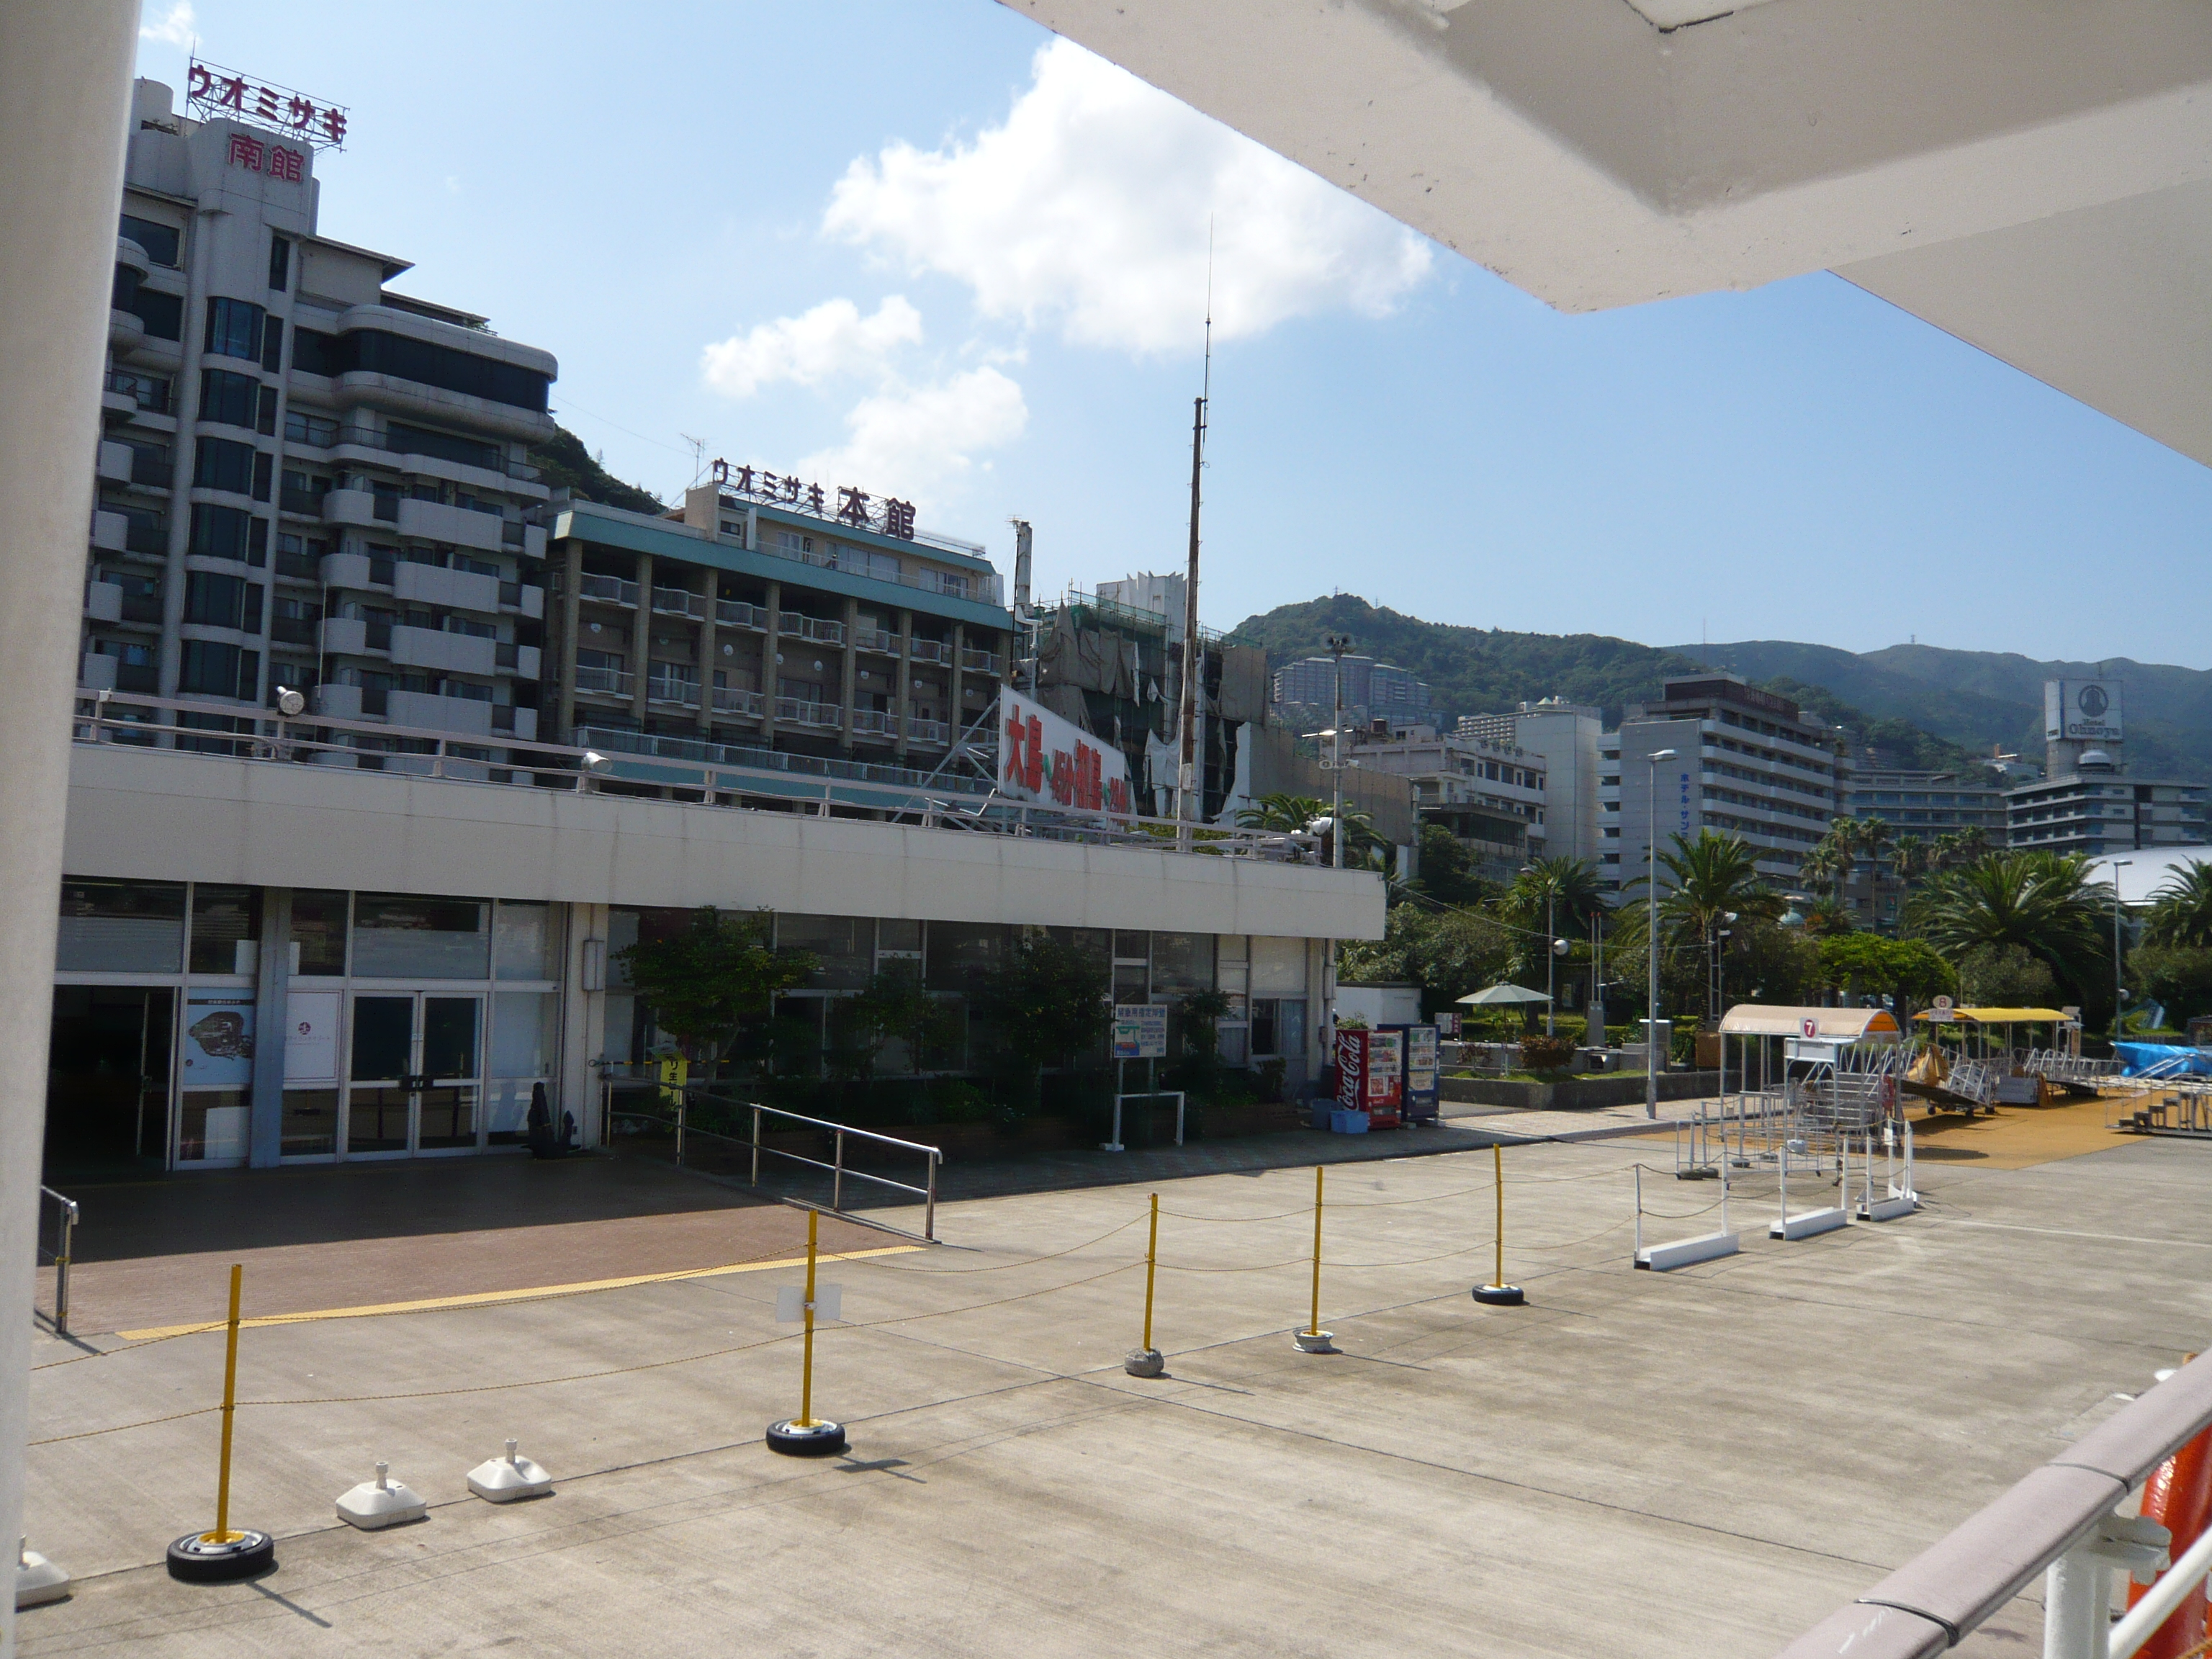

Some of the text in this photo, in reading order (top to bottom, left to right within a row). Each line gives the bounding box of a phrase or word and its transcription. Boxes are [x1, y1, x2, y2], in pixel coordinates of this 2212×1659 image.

[189, 64, 347, 142] ウオミサキ
[228, 132, 305, 183] 南館
[714, 457, 916, 540] ウオミサキ 本館
[1938, 997, 1947, 1007] 8
[1806, 1022, 1813, 1035] 7
